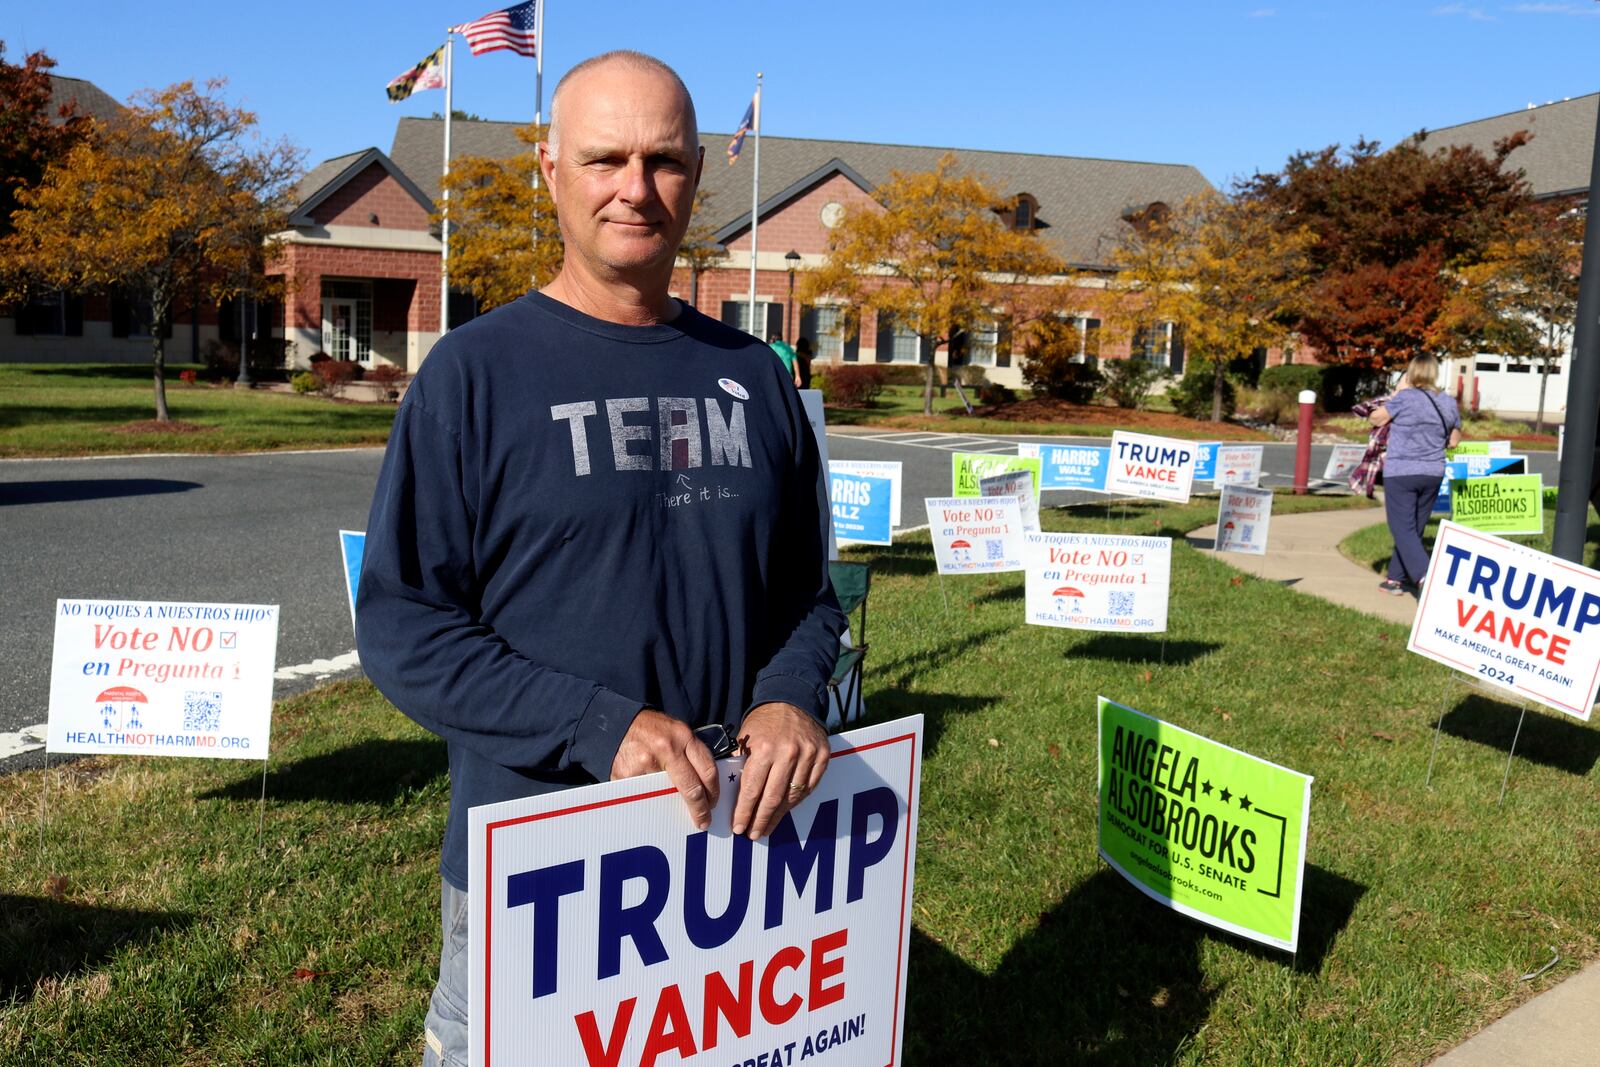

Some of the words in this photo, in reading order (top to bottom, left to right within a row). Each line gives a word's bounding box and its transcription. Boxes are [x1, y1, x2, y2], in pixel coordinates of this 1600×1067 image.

[550, 397, 753, 477] TEAM
[1051, 448, 1100, 466] HARRIS
[1118, 441, 1190, 467] TRUMP
[1058, 465, 1092, 475] WALZ
[1125, 464, 1177, 482] VANCE
[656, 493, 691, 507] There
[700, 487, 710, 502] it
[832, 479, 871, 506] RRIS
[1457, 483, 1501, 500] ANGELA
[832, 504, 860, 520] ALZ
[943, 510, 971, 522] Vote
[975, 508, 993, 522] NO
[1456, 498, 1527, 516] ALSOBROOKS
[956, 526, 1000, 537] Pregunta
[1003, 524, 1009, 534] 1
[1028, 534, 1042, 544] NO
[1044, 535, 1080, 545] TOQUES
[1082, 536, 1089, 544] A
[1091, 537, 1139, 547] NUESTROS
[1141, 538, 1168, 550] HIJOS
[1049, 548, 1091, 565] Vote
[1097, 550, 1128, 567] NO
[1043, 570, 1061, 581] en
[1065, 569, 1134, 586] Pregunta
[1140, 572, 1148, 585] 1
[1445, 545, 1600, 633] TRUMP
[60, 603, 81, 616] NO
[86, 604, 141, 619] TOQUES
[144, 605, 153, 618] A
[157, 606, 230, 621] NUESTROS
[234, 608, 274, 624] HIJOS
[93, 624, 159, 649] Vote
[168, 626, 214, 652] NO
[1457, 598, 1571, 666] VANCE
[1434, 628, 1459, 644] MAKE
[1461, 639, 1503, 660] AMERICA
[1505, 655, 1537, 673] GREAT
[1538, 668, 1574, 688] AGAIN!
[82, 661, 110, 676] en
[117, 658, 223, 683] Pregunta
[1478, 663, 1515, 685] 2024
[66, 732, 250, 749] HEALTHNOTHARMMD.ORG
[1111, 725, 1200, 803] ANGELA
[1108, 767, 1257, 873] ALSOBROOKS
[1107, 811, 1147, 846] DEMOCRAT
[1148, 840, 1169, 859] FOR
[1172, 851, 1194, 871] U.S.
[1198, 863, 1247, 891] SENATE
[1130, 851, 1223, 901] angelaalsobrooks.com
[507, 786, 899, 999] TRUMP
[573, 928, 849, 1067] VANCE
[801, 1013, 866, 1061] AGAIN!
